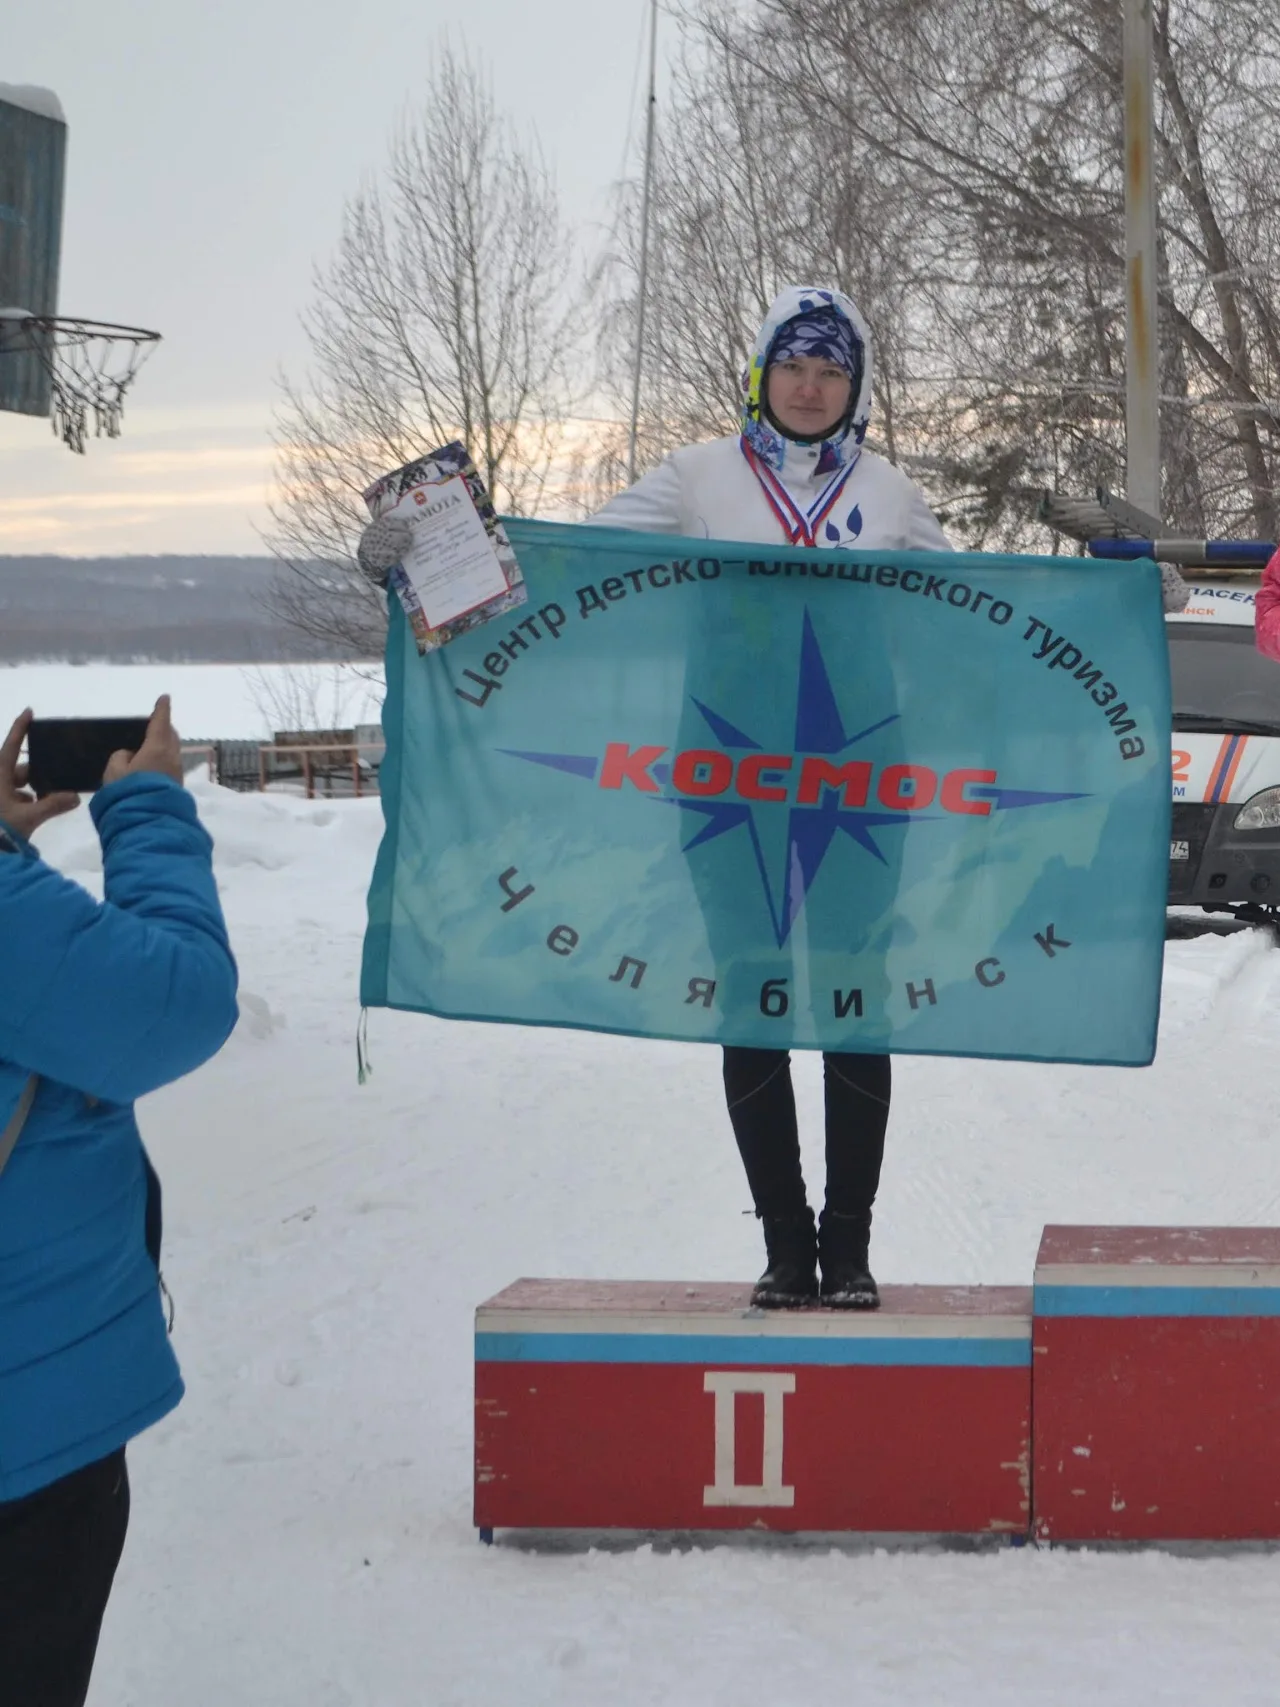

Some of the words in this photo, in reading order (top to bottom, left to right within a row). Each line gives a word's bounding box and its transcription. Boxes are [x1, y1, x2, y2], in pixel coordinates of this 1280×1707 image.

[407, 493, 463, 526] АМОТА
[454, 602, 567, 709] Центр
[575, 557, 1015, 627] детско-юношеского
[1022, 615, 1146, 761] туризма
[598, 742, 998, 816] КОСМОС
[497, 866, 1072, 1018] Челябинск
[703, 1371, 796, 1507] II
